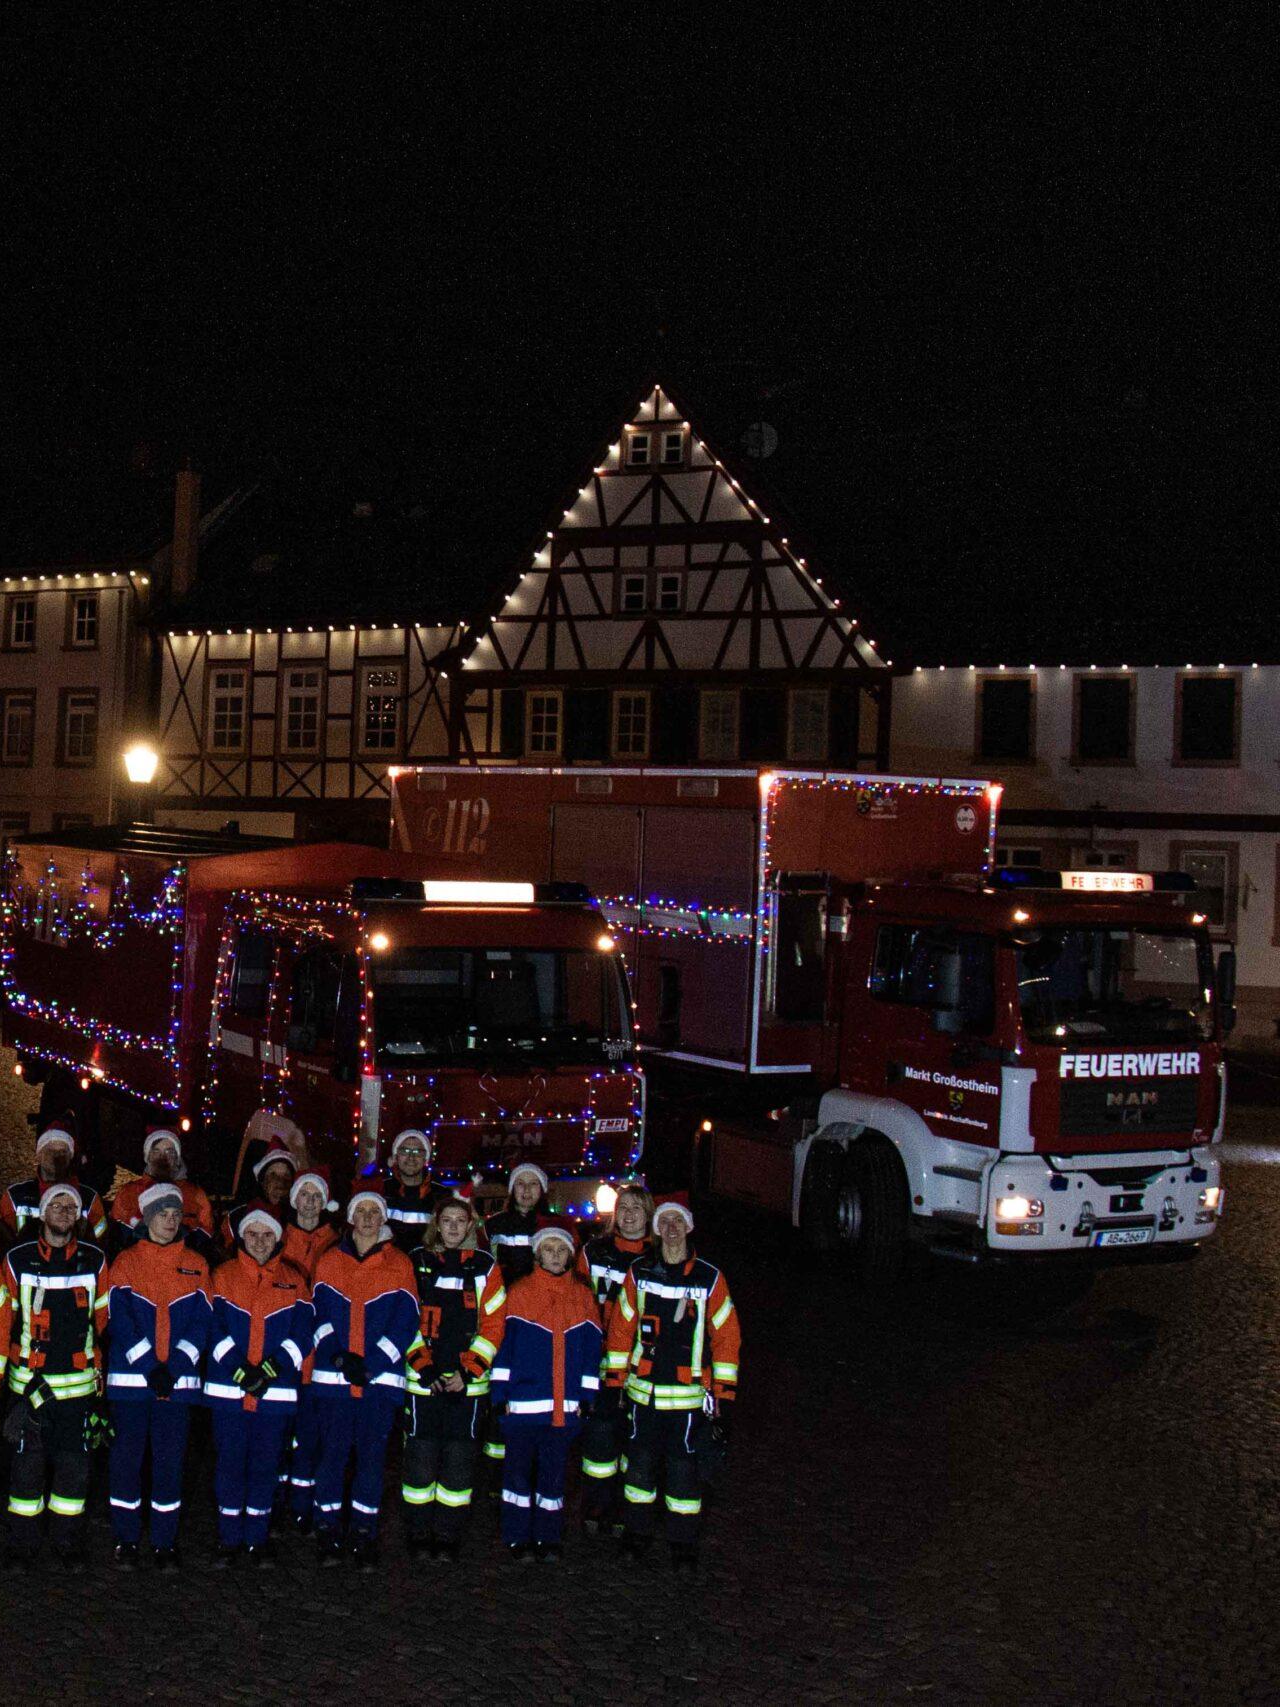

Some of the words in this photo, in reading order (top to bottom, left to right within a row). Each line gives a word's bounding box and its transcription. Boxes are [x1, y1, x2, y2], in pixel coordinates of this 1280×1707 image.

[442, 797, 490, 855] 112
[1071, 876, 1145, 889] FEERWEHR
[1059, 1051, 1201, 1078] FEUERWEHR
[905, 1066, 931, 1082] Markt
[932, 1072, 999, 1096] Großostheim
[1106, 1090, 1160, 1106] MAN
[480, 1131, 543, 1147] MAN
